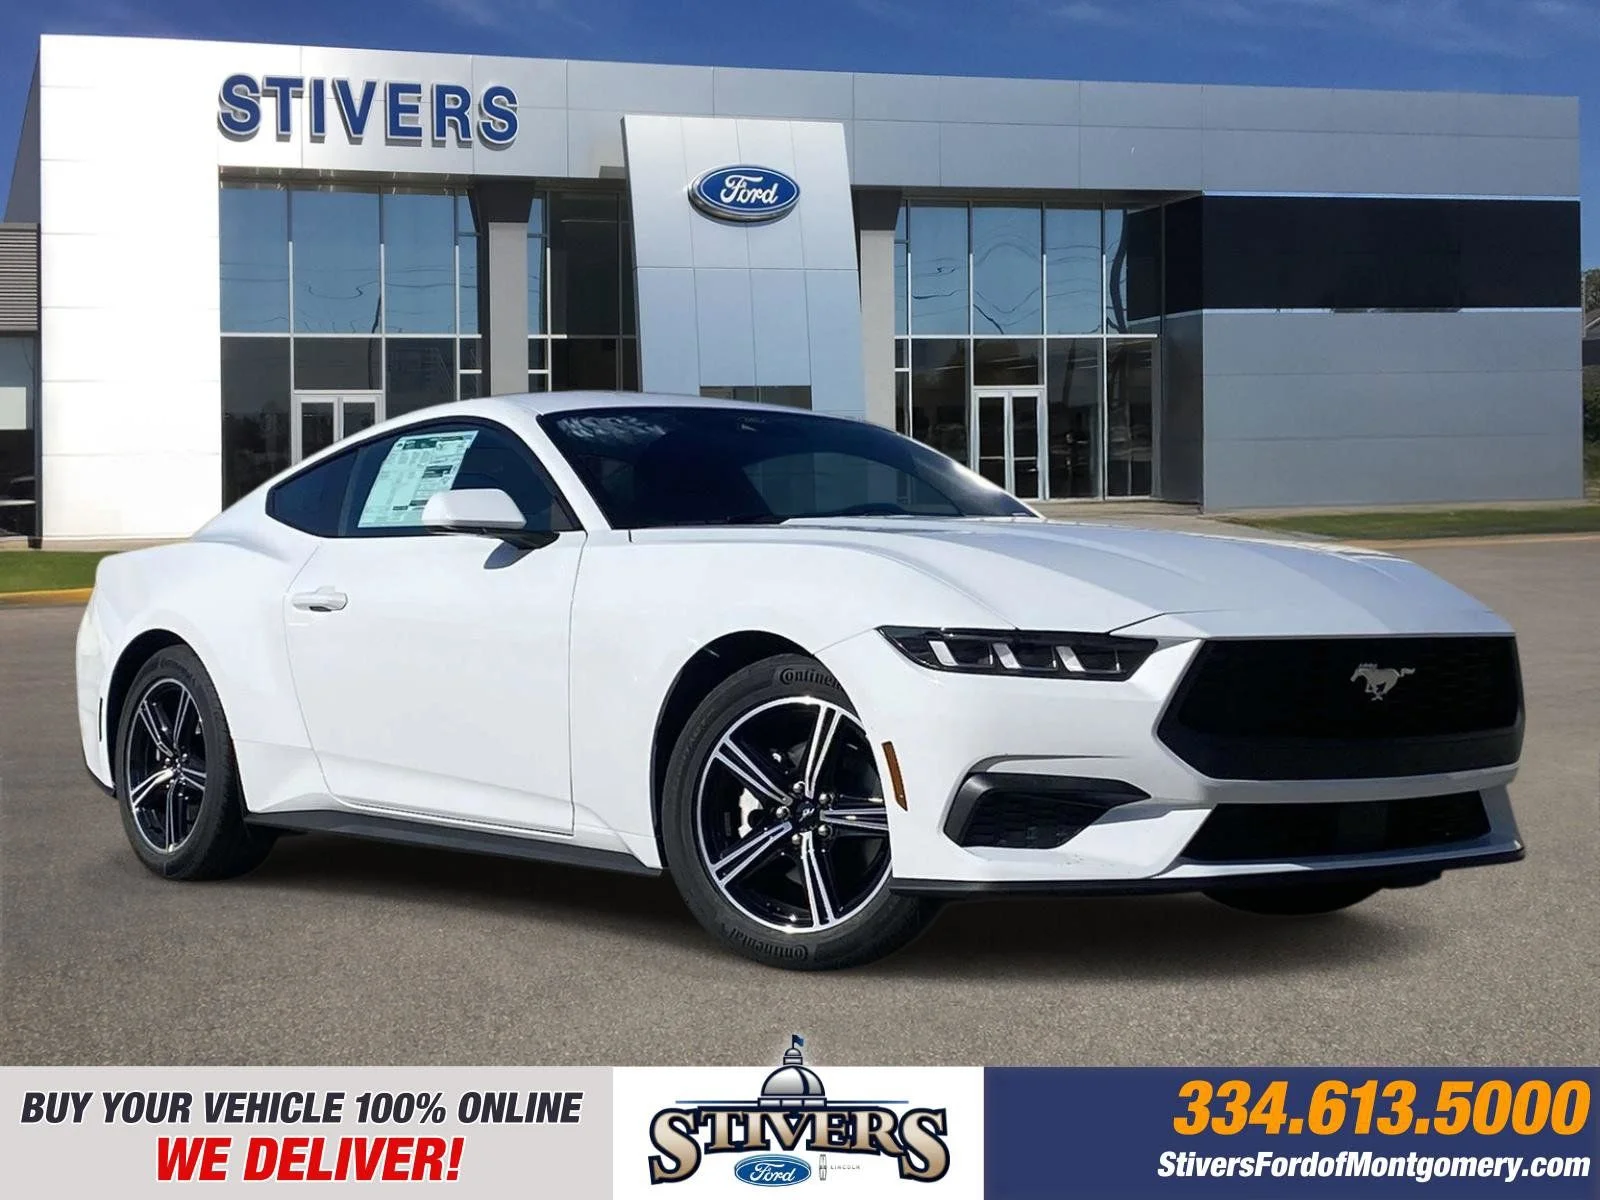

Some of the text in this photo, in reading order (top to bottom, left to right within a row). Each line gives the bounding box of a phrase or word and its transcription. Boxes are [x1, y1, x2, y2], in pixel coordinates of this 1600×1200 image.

[220, 74, 518, 144] STIVERS
[720, 175, 779, 204] Ford
[780, 668, 841, 690] Continen
[728, 928, 809, 960] Continental
